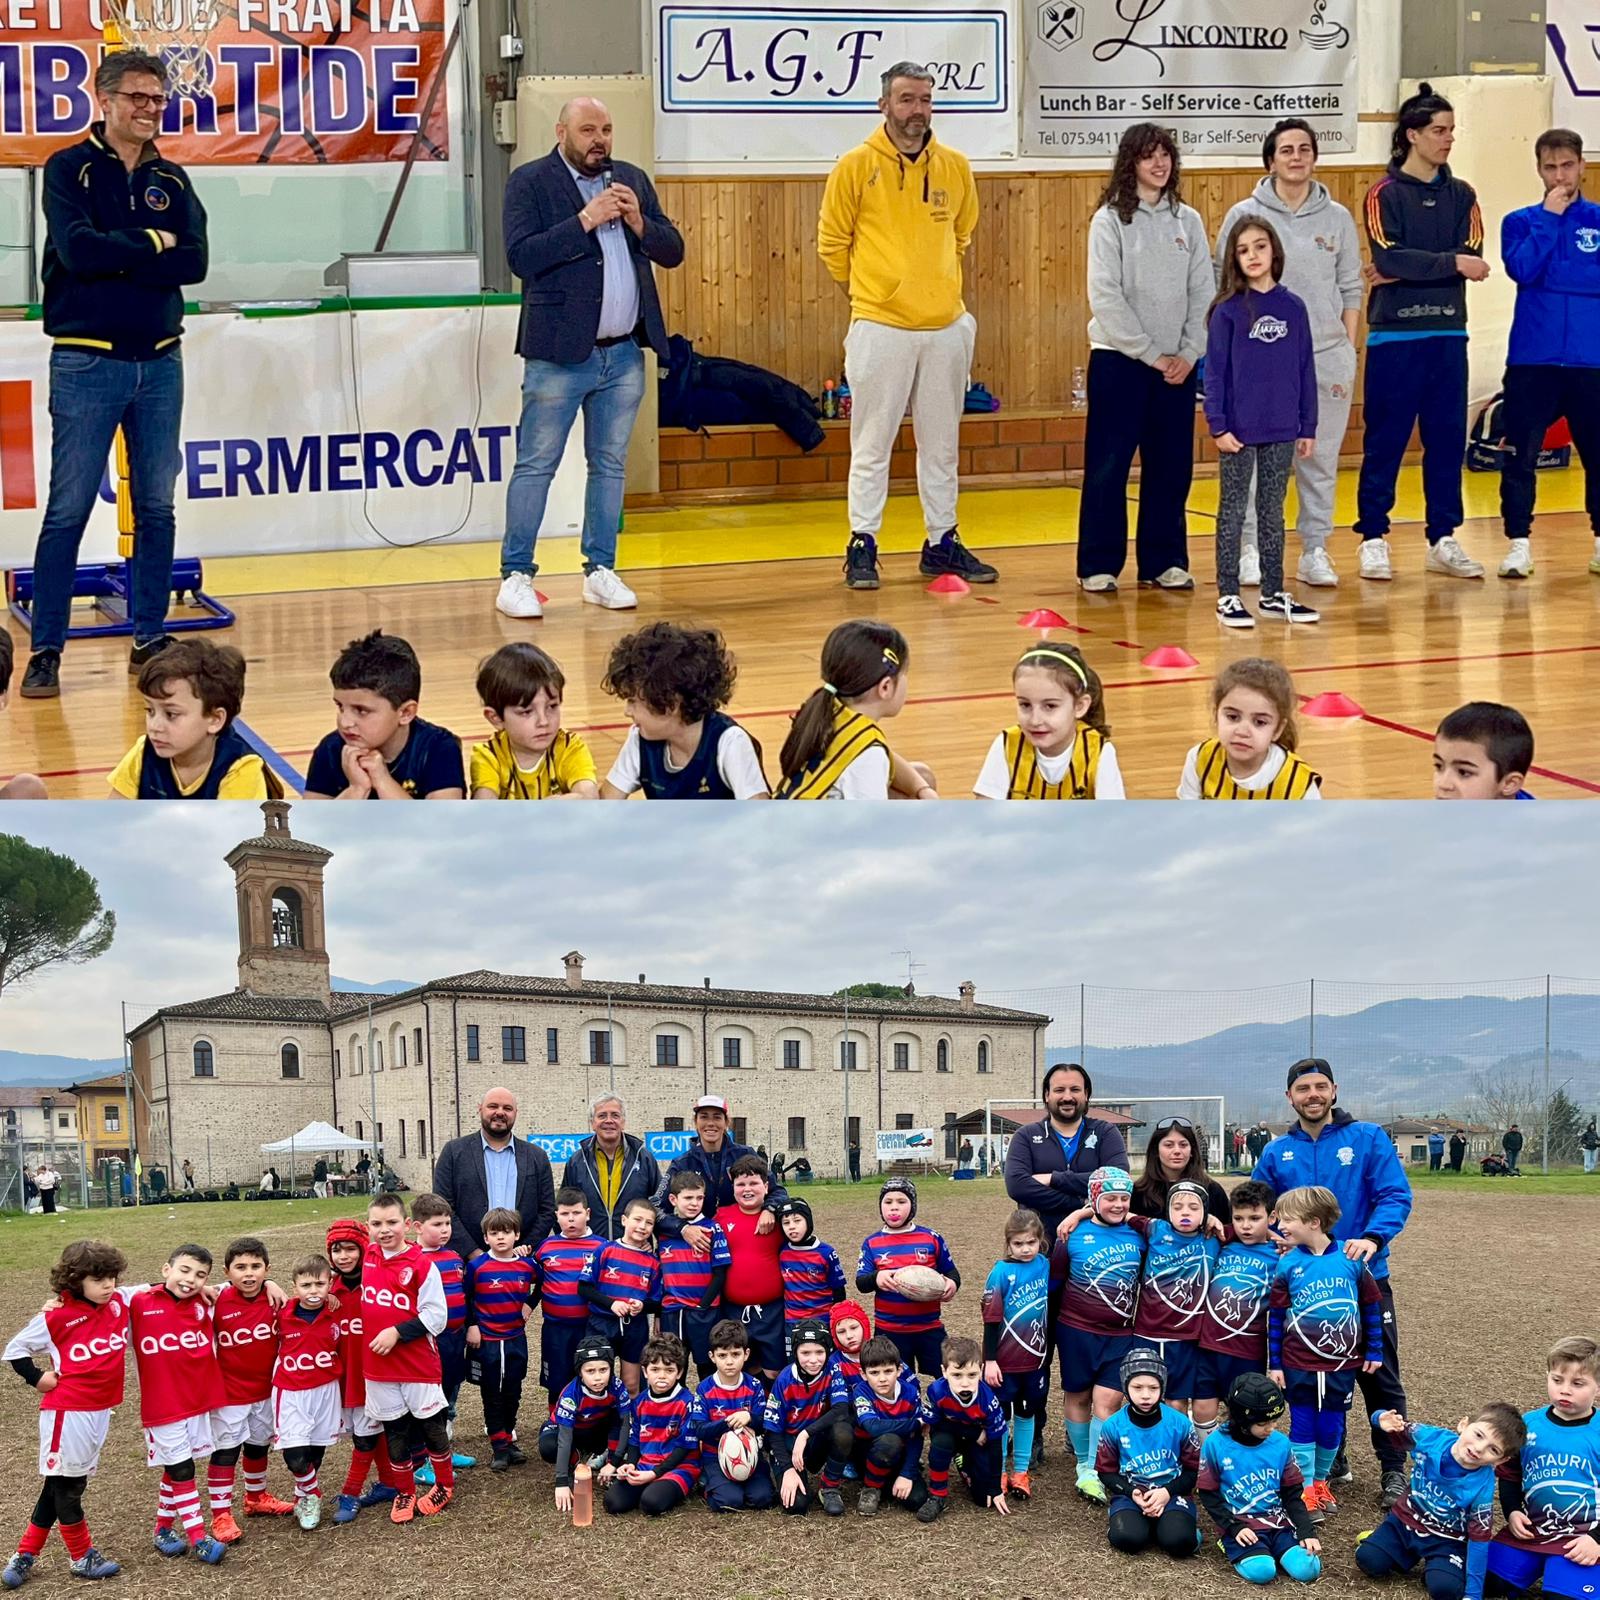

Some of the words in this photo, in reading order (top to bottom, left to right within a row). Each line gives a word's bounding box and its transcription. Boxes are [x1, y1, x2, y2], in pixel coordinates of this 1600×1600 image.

[0, 0, 62, 30] ET
[676, 27, 883, 97] A.G.F
[0, 45, 420, 136] BRTIDE
[1040, 94, 1091, 111] Lunch
[1096, 95, 1126, 111] Bar
[1141, 93, 1175, 110] Self
[1177, 94, 1241, 110] Service
[1254, 92, 1340, 110] Caffetteria
[1038, 131, 1059, 145] Tel.
[1061, 132, 1124, 145] 075.9411
[1182, 131, 1203, 144] Bar
[1206, 129, 1267, 144] Self-Servi
[1249, 321, 1288, 338] LAKERS
[100, 425, 520, 504] ERMERCAT
[650, 1136, 691, 1154] CENT
[1083, 1243, 1136, 1272] CENTAURI
[1099, 1253, 1126, 1270] RUGBY
[1214, 1254, 1264, 1270] NTAURI
[1014, 1290, 1039, 1309] RUGBY
[1295, 1277, 1348, 1308] CENTAURI
[340, 1317, 364, 1335] ce
[141, 1330, 209, 1355] acea
[1523, 1453, 1587, 1482] CENTAURI
[1531, 1468, 1566, 1483] RUGBY
